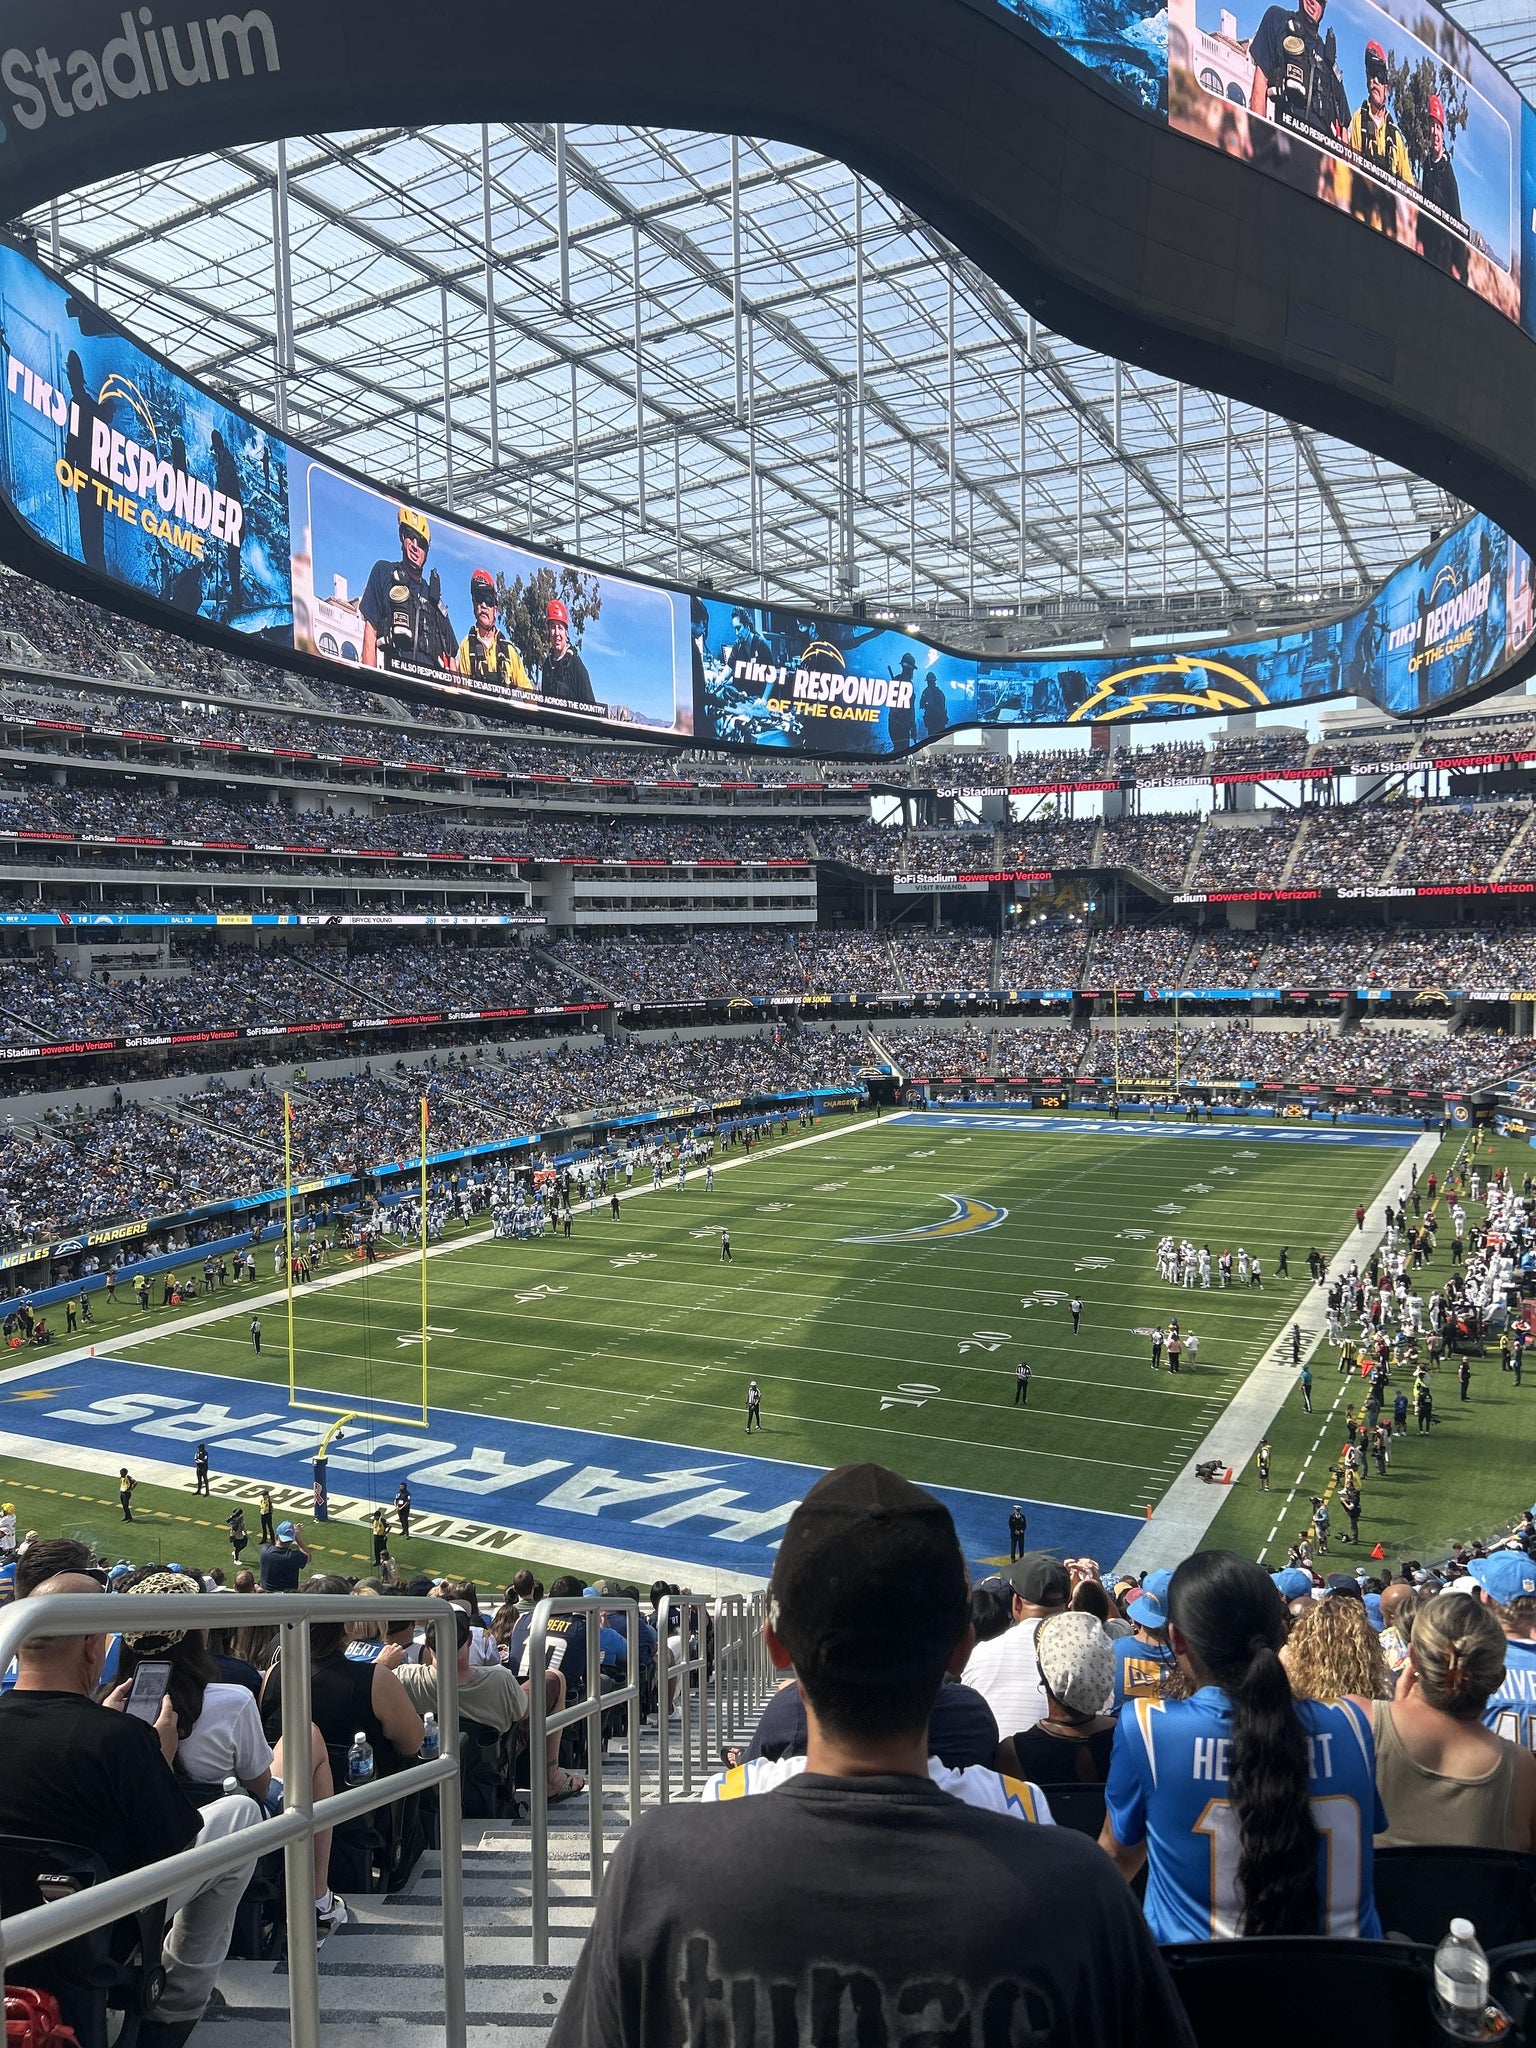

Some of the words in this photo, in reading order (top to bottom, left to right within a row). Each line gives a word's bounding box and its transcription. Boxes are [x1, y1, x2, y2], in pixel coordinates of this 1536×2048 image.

[1, 6, 281, 129] Stadium
[1282, 112, 1292, 126] HE
[1292, 119, 1309, 134] ALSO
[1309, 127, 1344, 154] RESPONDED
[1343, 145, 1352, 159] TO
[1352, 151, 1363, 166] THE
[91, 416, 244, 548] RESPONDER
[55, 459, 89, 493] OF
[92, 479, 138, 526] THE
[141, 509, 205, 559] GAME
[1424, 572, 1491, 648] RESPONDER
[1408, 653, 1424, 674] OF
[1424, 644, 1446, 667] THE
[1445, 625, 1475, 656] GAME
[391, 658, 401, 669] HE
[400, 662, 417, 674] ALSO
[417, 665, 453, 682] RESPONDED
[452, 675, 461, 684] TO
[461, 678, 474, 687] THE
[473, 680, 511, 696] DEVASTATING
[511, 688, 544, 702] SITUATIONS
[544, 696, 568, 708] ACROSS
[567, 701, 579, 710] THE
[579, 703, 606, 715] COUNTRY
[793, 669, 914, 709] RESPONDER
[766, 698, 792, 713] OF
[792, 701, 828, 718] THE
[830, 706, 881, 723] GAME
[1350, 764, 1379, 775] SoFi
[1380, 760, 1433, 773] Stadium
[1435, 755, 1491, 769] powered
[1494, 753, 1509, 764] by
[937, 788, 961, 798] SoFi
[962, 787, 1008, 796] Stadium
[1010, 783, 1058, 795] powered
[1059, 783, 1073, 793] by
[1136, 778, 1162, 788] SoFi
[1163, 776, 1211, 787] Stadium
[1213, 773, 1265, 784] powered
[1265, 771, 1281, 782] by
[893, 874, 916, 884] SoFi
[917, 873, 957, 883] Stadium
[959, 872, 1002, 883] powered
[1002, 872, 1014, 882] by
[1016, 871, 1052, 880] Verizon
[935, 883, 968, 891] RWANDA
[1173, 892, 1207, 903] adium
[1208, 890, 1258, 902] powered
[1258, 890, 1273, 901] by
[1337, 887, 1366, 898] SoFi
[1366, 886, 1416, 897] Stadium
[1418, 884, 1472, 896] powered
[1473, 883, 1489, 894] by
[771, 995, 793, 1004] FOLLOW
[794, 995, 802, 1003] US
[812, 994, 832, 1003] SOCIAL
[246, 1028, 261, 1036] SoFi
[262, 1026, 286, 1035] Stadium
[287, 1024, 313, 1034] powered
[313, 1024, 321, 1032] by
[352, 1020, 365, 1028] SoFi
[366, 1018, 388, 1026] Stadium
[389, 1016, 412, 1025] powered
[412, 1016, 419, 1024] by
[7, 1047, 40, 1058] Stadium
[41, 1042, 75, 1056] powered
[75, 1043, 85, 1052] by
[125, 1038, 142, 1047] SoFi
[143, 1036, 171, 1046] Stadium
[172, 1032, 201, 1044] powered
[201, 1032, 210, 1041] by
[712, 1099, 742, 1110] CHARGERS
[1040, 1097, 1059, 1107] 7:25
[939, 1118, 1042, 1128] LOS
[1053, 1120, 1361, 1141] ANGELES
[1, 1247, 50, 1269] NGELES
[87, 1222, 148, 1246] CHARGERS
[1020, 1289, 1069, 1309] 30
[957, 1331, 1012, 1354] 20
[880, 1383, 941, 1411] 10
[42, 1393, 803, 1549] HARGERS
[367, 1507, 524, 1550] NEVER
[345, 1639, 379, 1659] BERT
